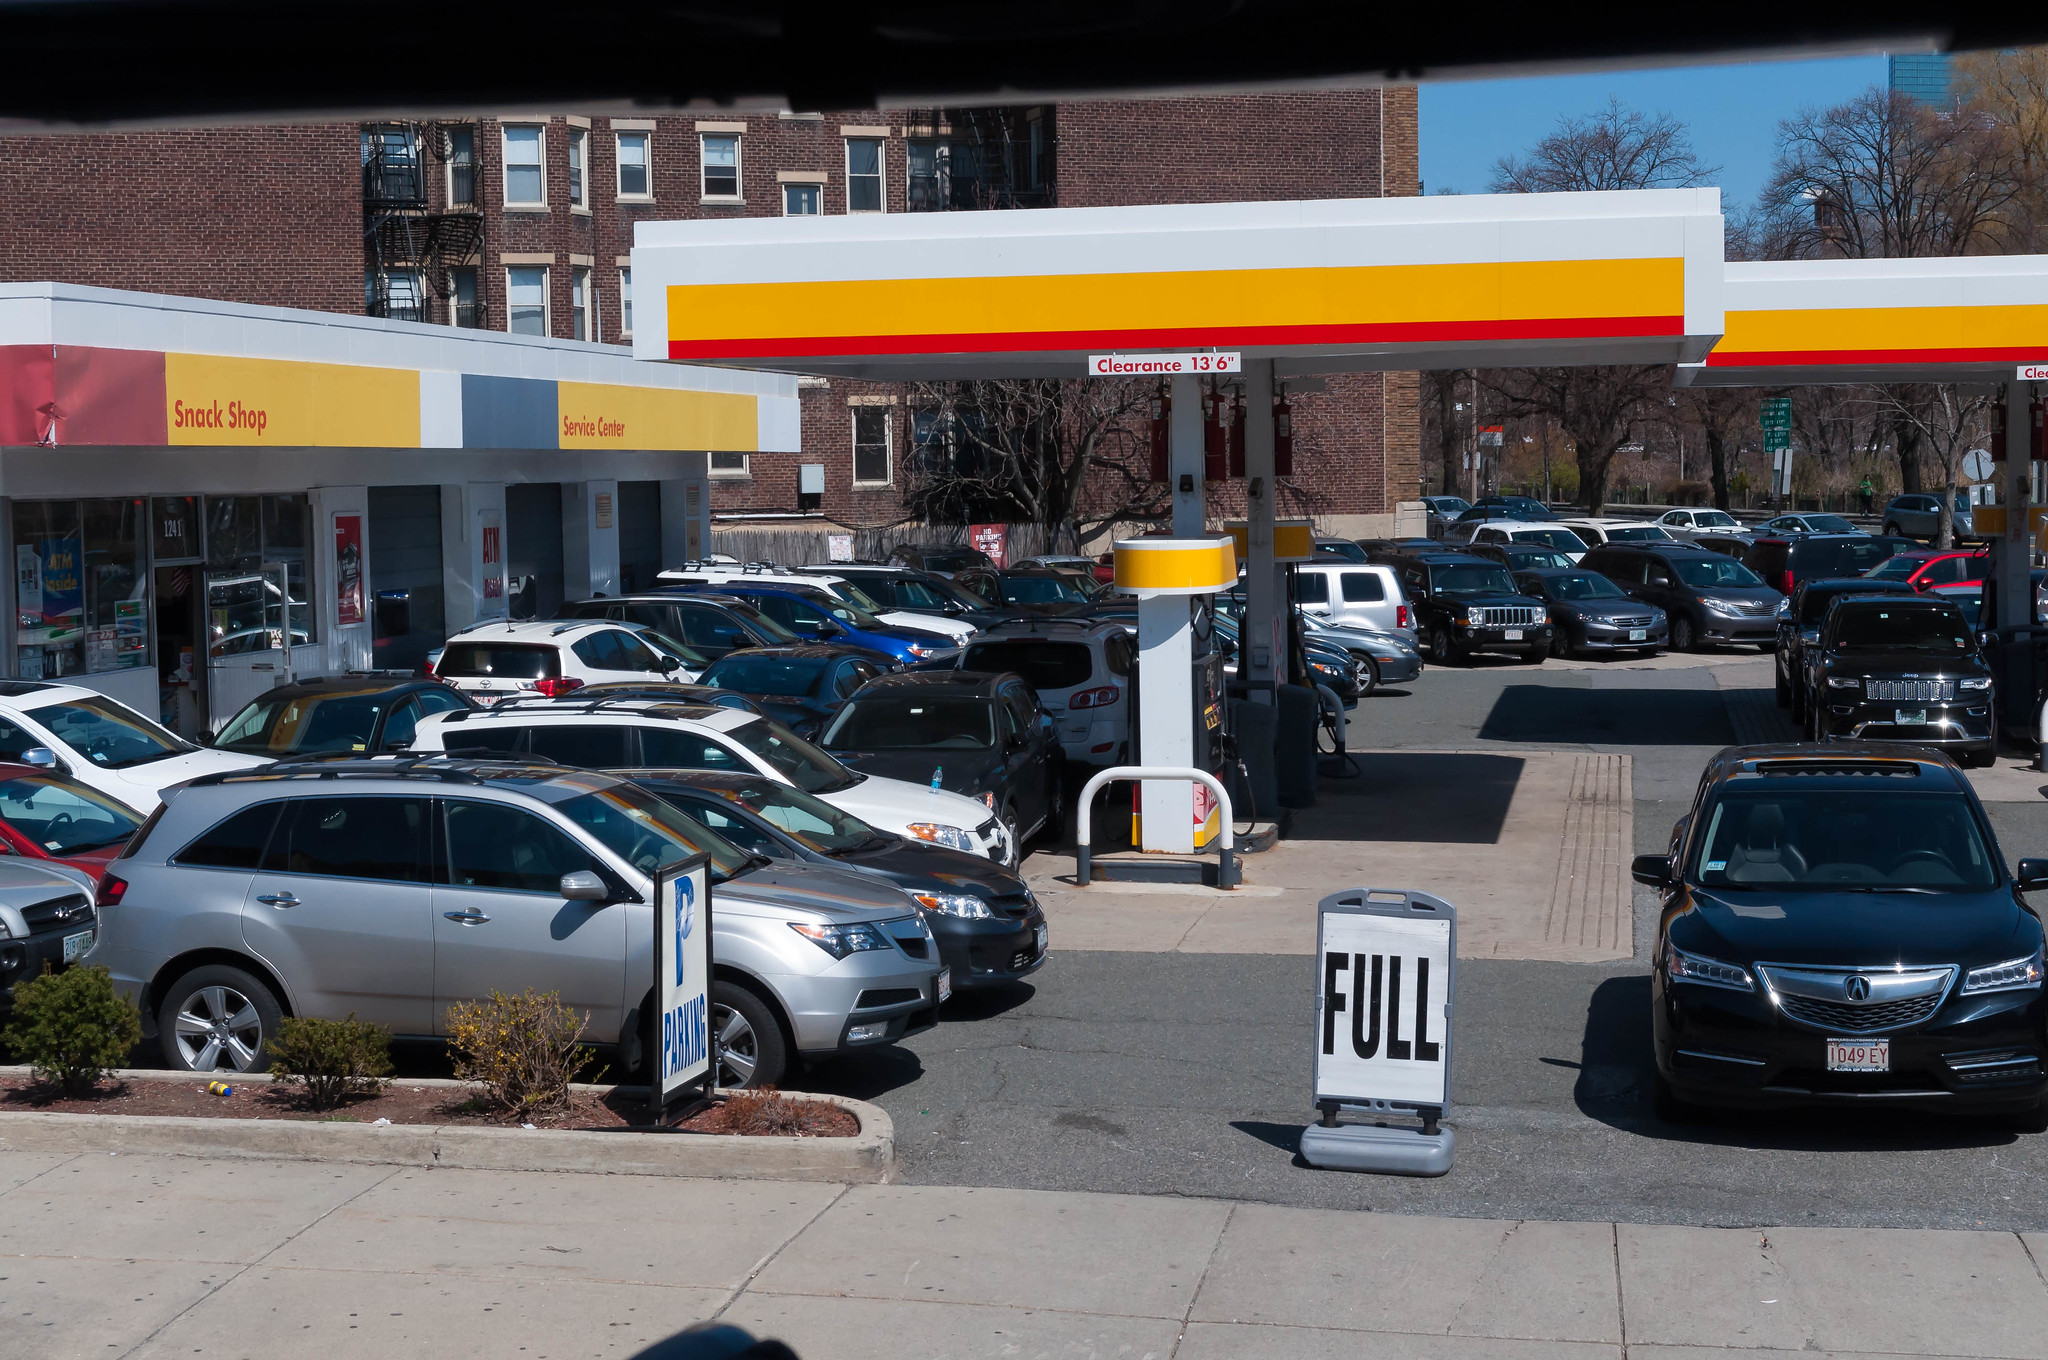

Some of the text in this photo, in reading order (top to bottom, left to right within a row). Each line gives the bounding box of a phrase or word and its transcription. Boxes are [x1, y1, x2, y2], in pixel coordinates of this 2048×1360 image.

[1097, 357, 1182, 373] Clearance
[174, 399, 267, 436] Snack Shop
[563, 415, 626, 437] Service Center
[163, 519, 182, 538] 1241
[975, 533, 1002, 541] PARKING
[49, 553, 73, 571] ATM
[673, 875, 695, 988] P
[1322, 951, 1440, 1062] FULL
[663, 992, 707, 1080] PARKING
[1869, 1047, 1888, 1064] EY
